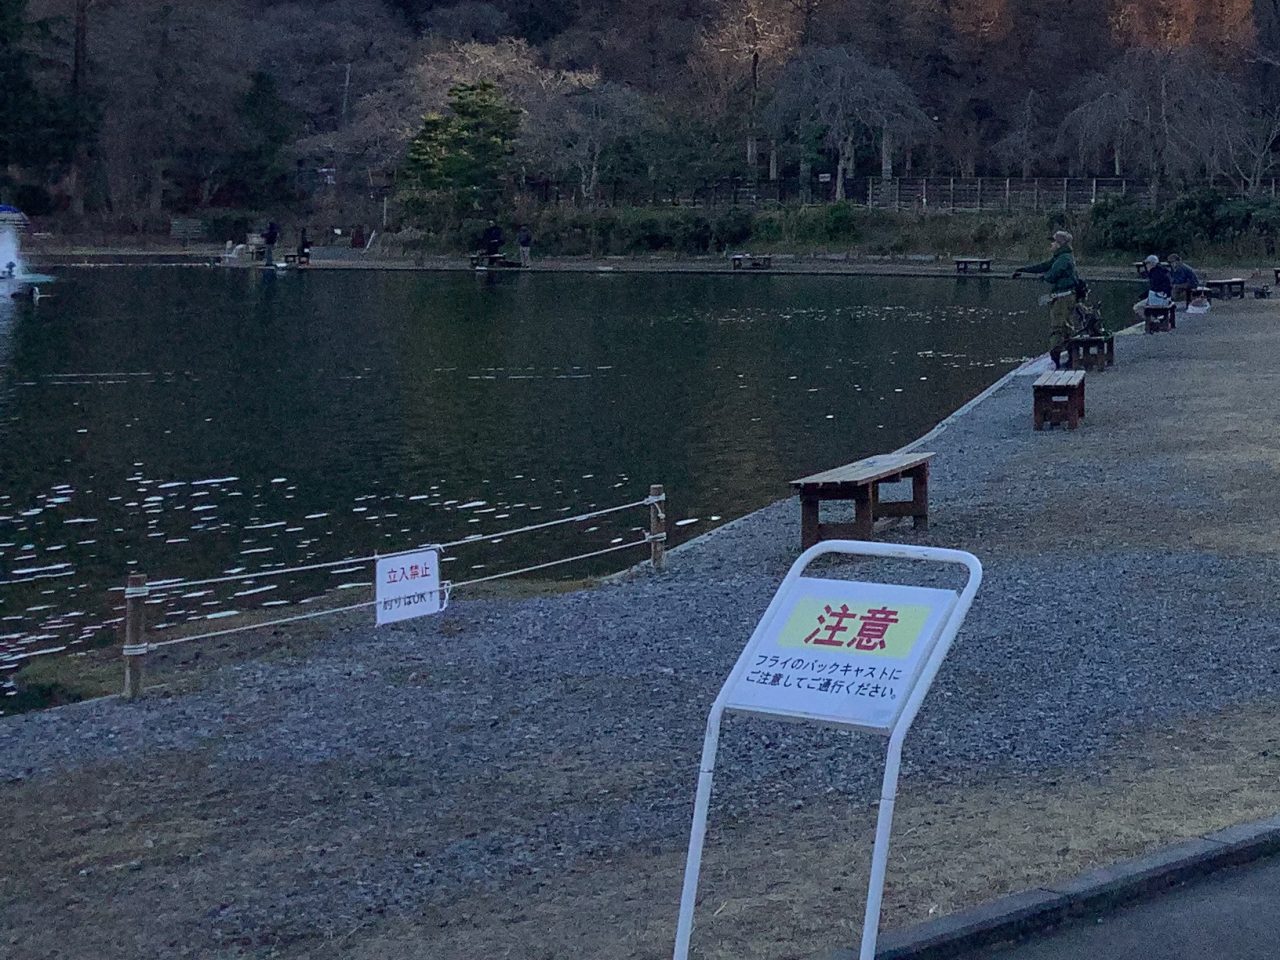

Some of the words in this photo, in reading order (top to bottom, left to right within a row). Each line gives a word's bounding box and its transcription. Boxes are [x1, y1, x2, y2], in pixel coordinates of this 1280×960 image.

[386, 562, 431, 584] 立入禁止
[803, 603, 899, 651] 注意
[755, 655, 902, 680] フライのバックキャストに
